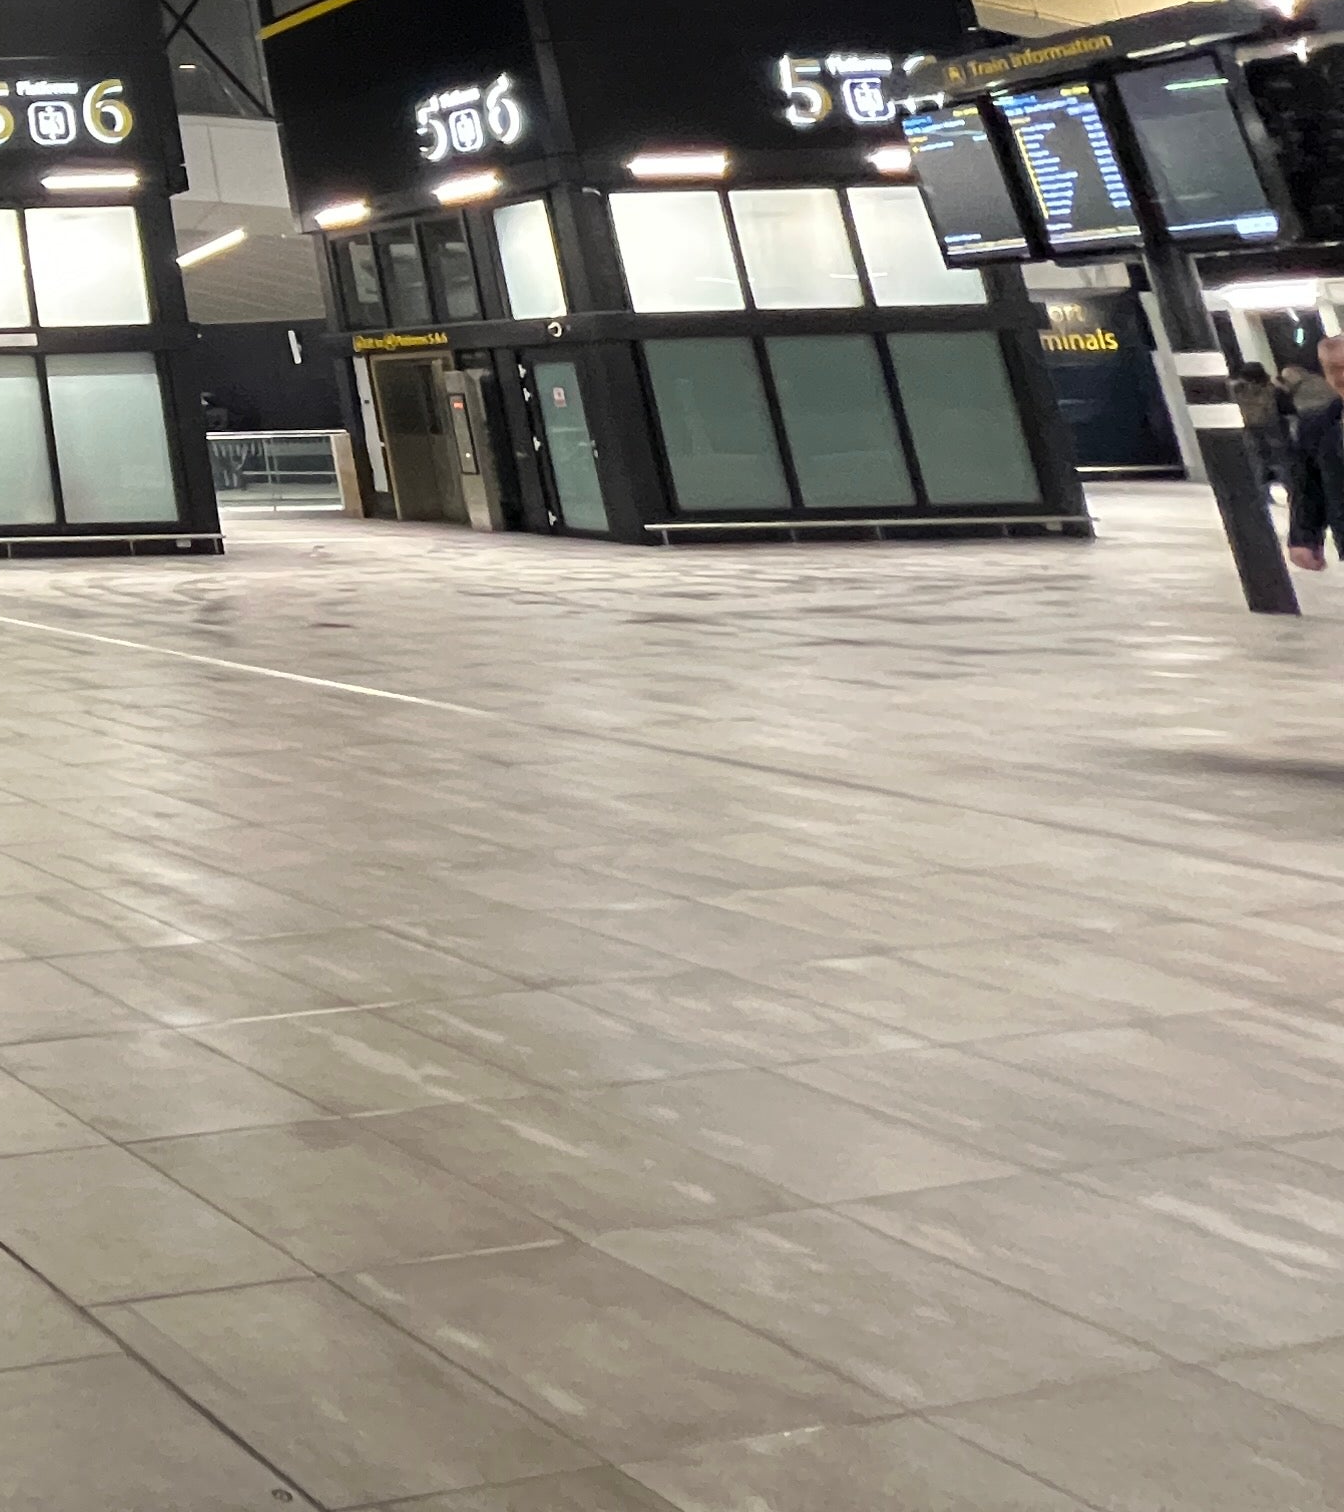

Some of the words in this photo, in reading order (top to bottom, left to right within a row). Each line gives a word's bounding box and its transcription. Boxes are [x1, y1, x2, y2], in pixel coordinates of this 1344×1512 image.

[83, 79, 133, 144] 6
[416, 93, 448, 162] 5
[486, 72, 522, 145] 6
[779, 54, 832, 127] 5
